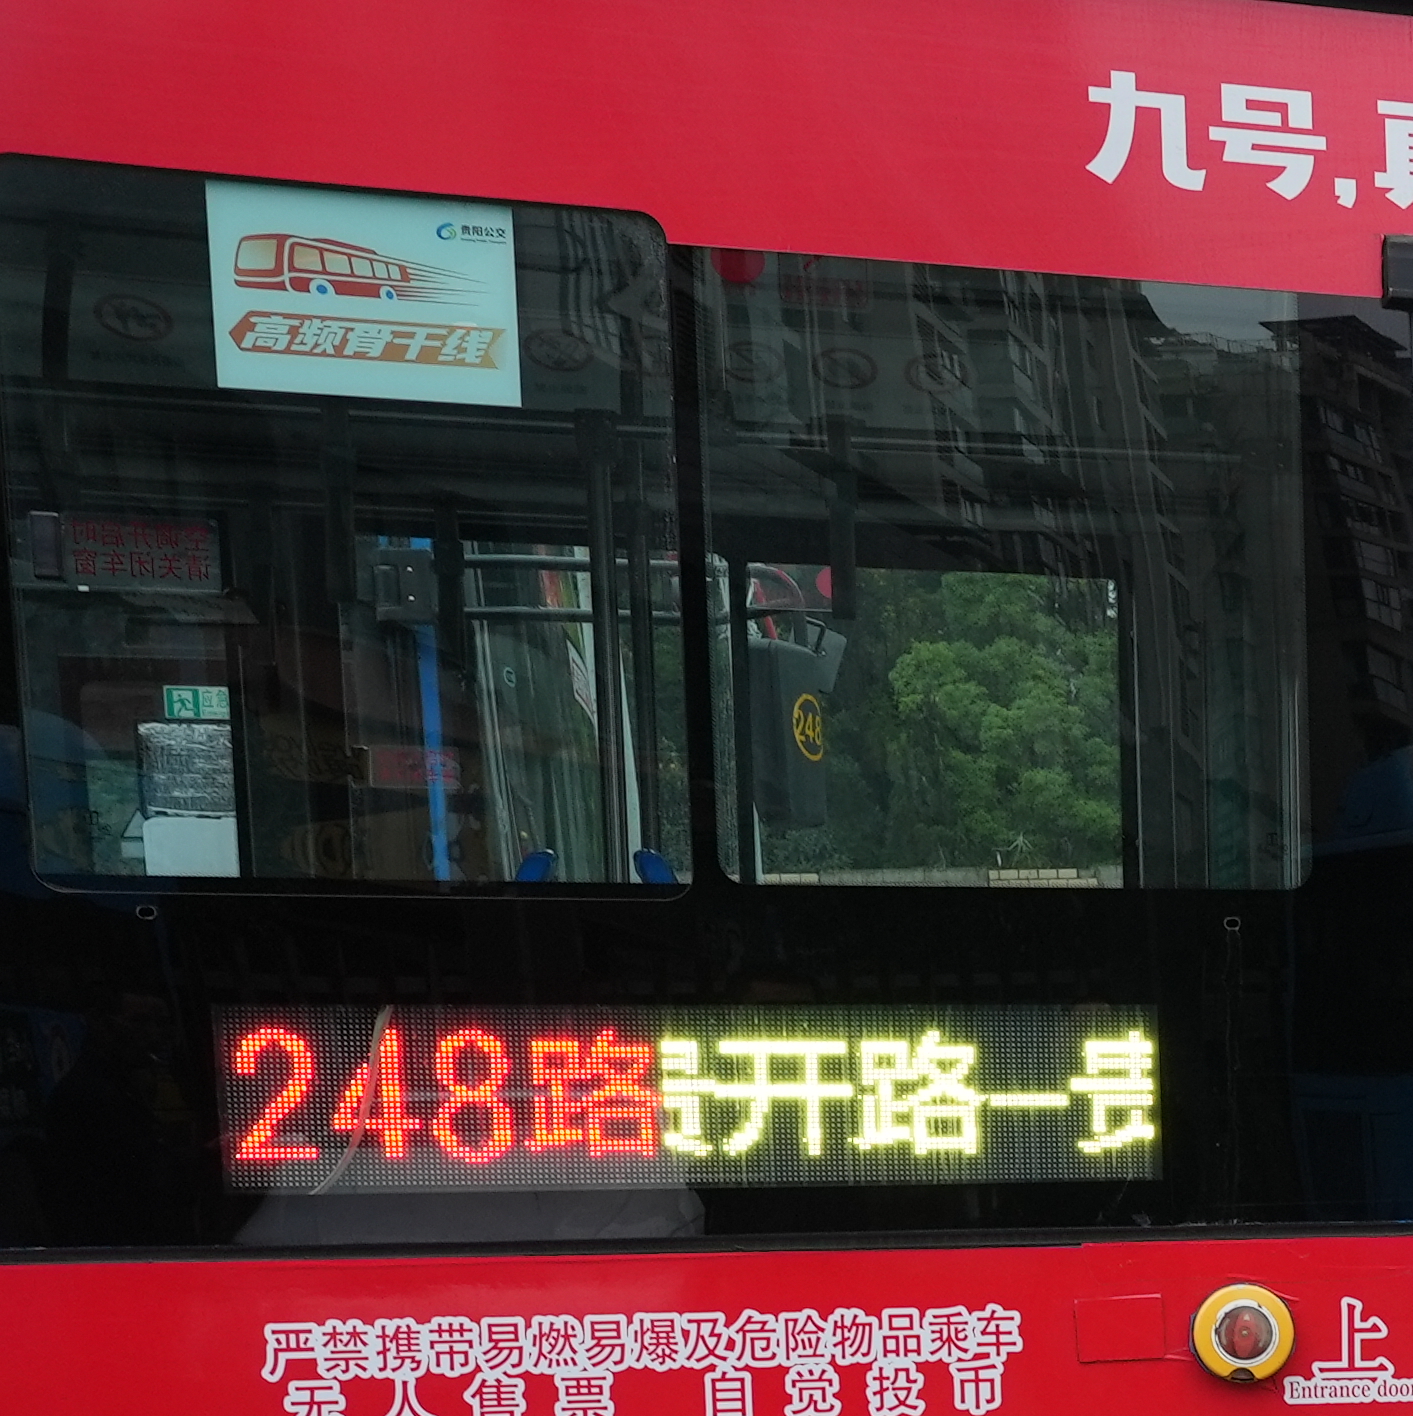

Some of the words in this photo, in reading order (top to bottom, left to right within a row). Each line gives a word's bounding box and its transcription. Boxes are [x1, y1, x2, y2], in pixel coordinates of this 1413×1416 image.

[461, 224, 507, 239] 贵阳公交
[240, 314, 494, 364] 高频骨干线
[794, 709, 822, 746] 248
[232, 1027, 660, 1165] 248路
[263, 1305, 1022, 1380] 严禁携带易燃易爆及危险物品乘车
[1312, 1296, 1395, 1379] 上
[1289, 1380, 1372, 1401] Entrance
